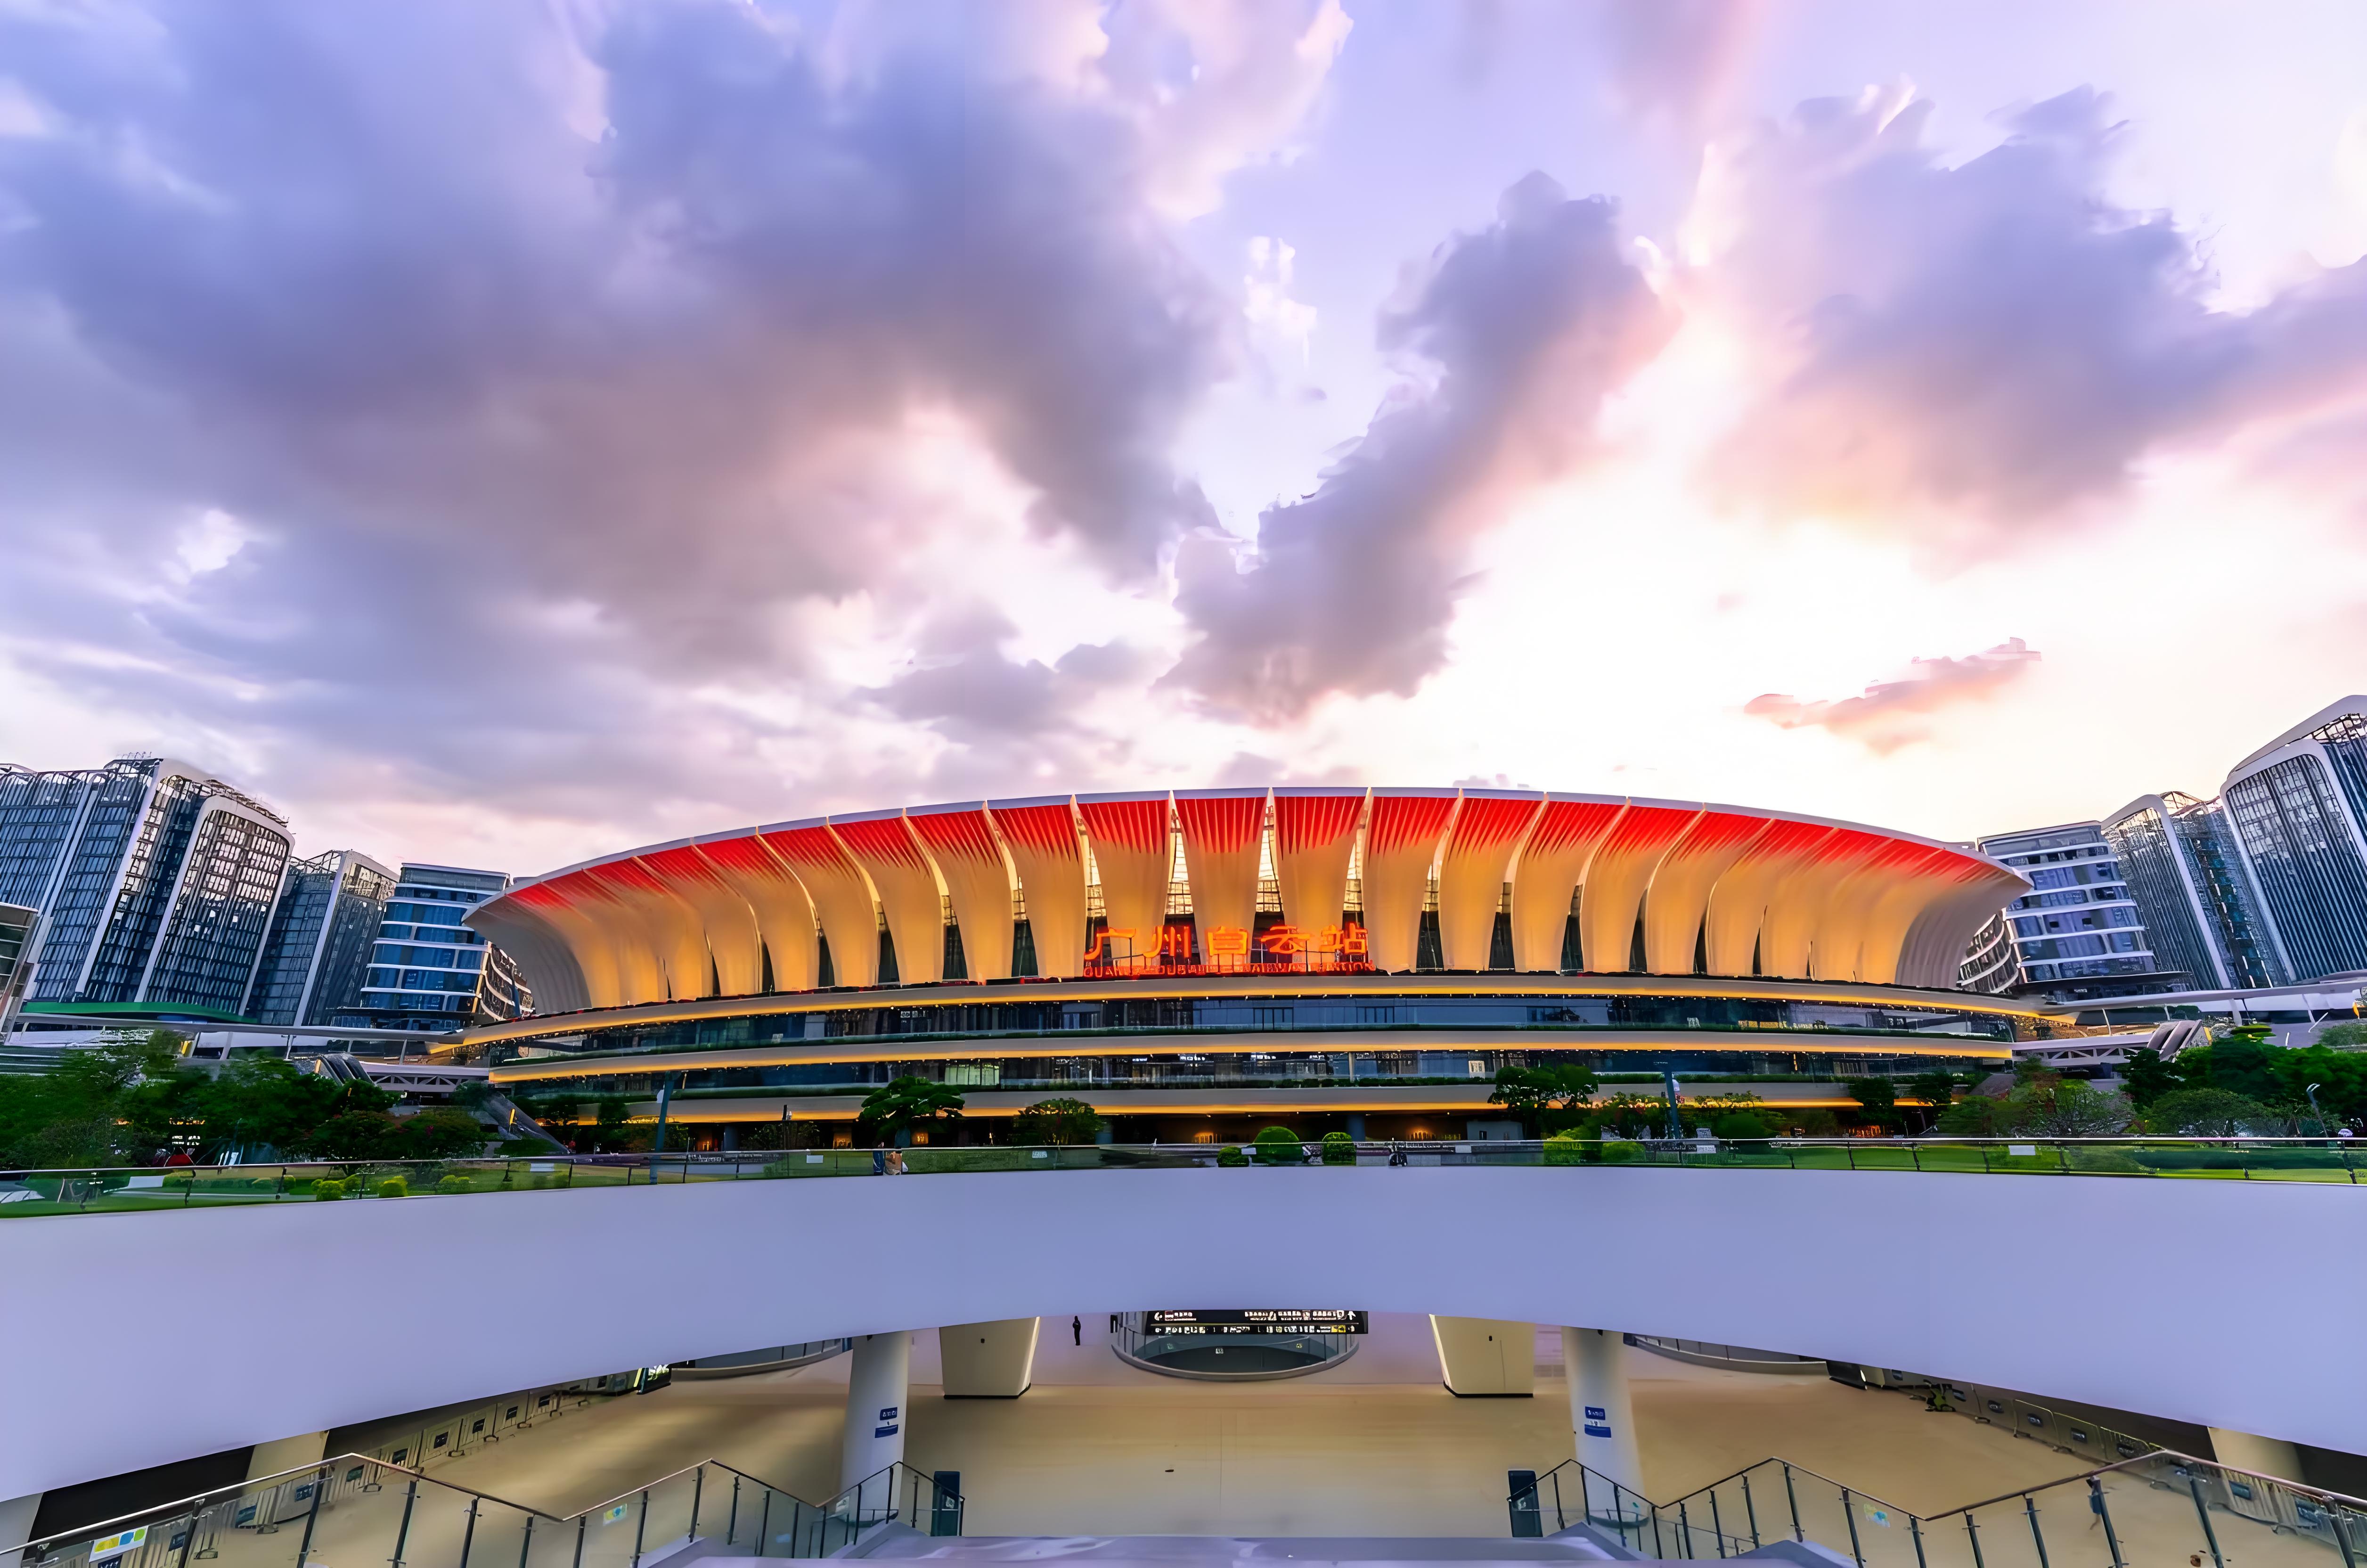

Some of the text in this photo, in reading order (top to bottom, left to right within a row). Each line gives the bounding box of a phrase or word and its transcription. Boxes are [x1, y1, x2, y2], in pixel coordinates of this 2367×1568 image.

[1084, 922, 1369, 960] 广州白云站
